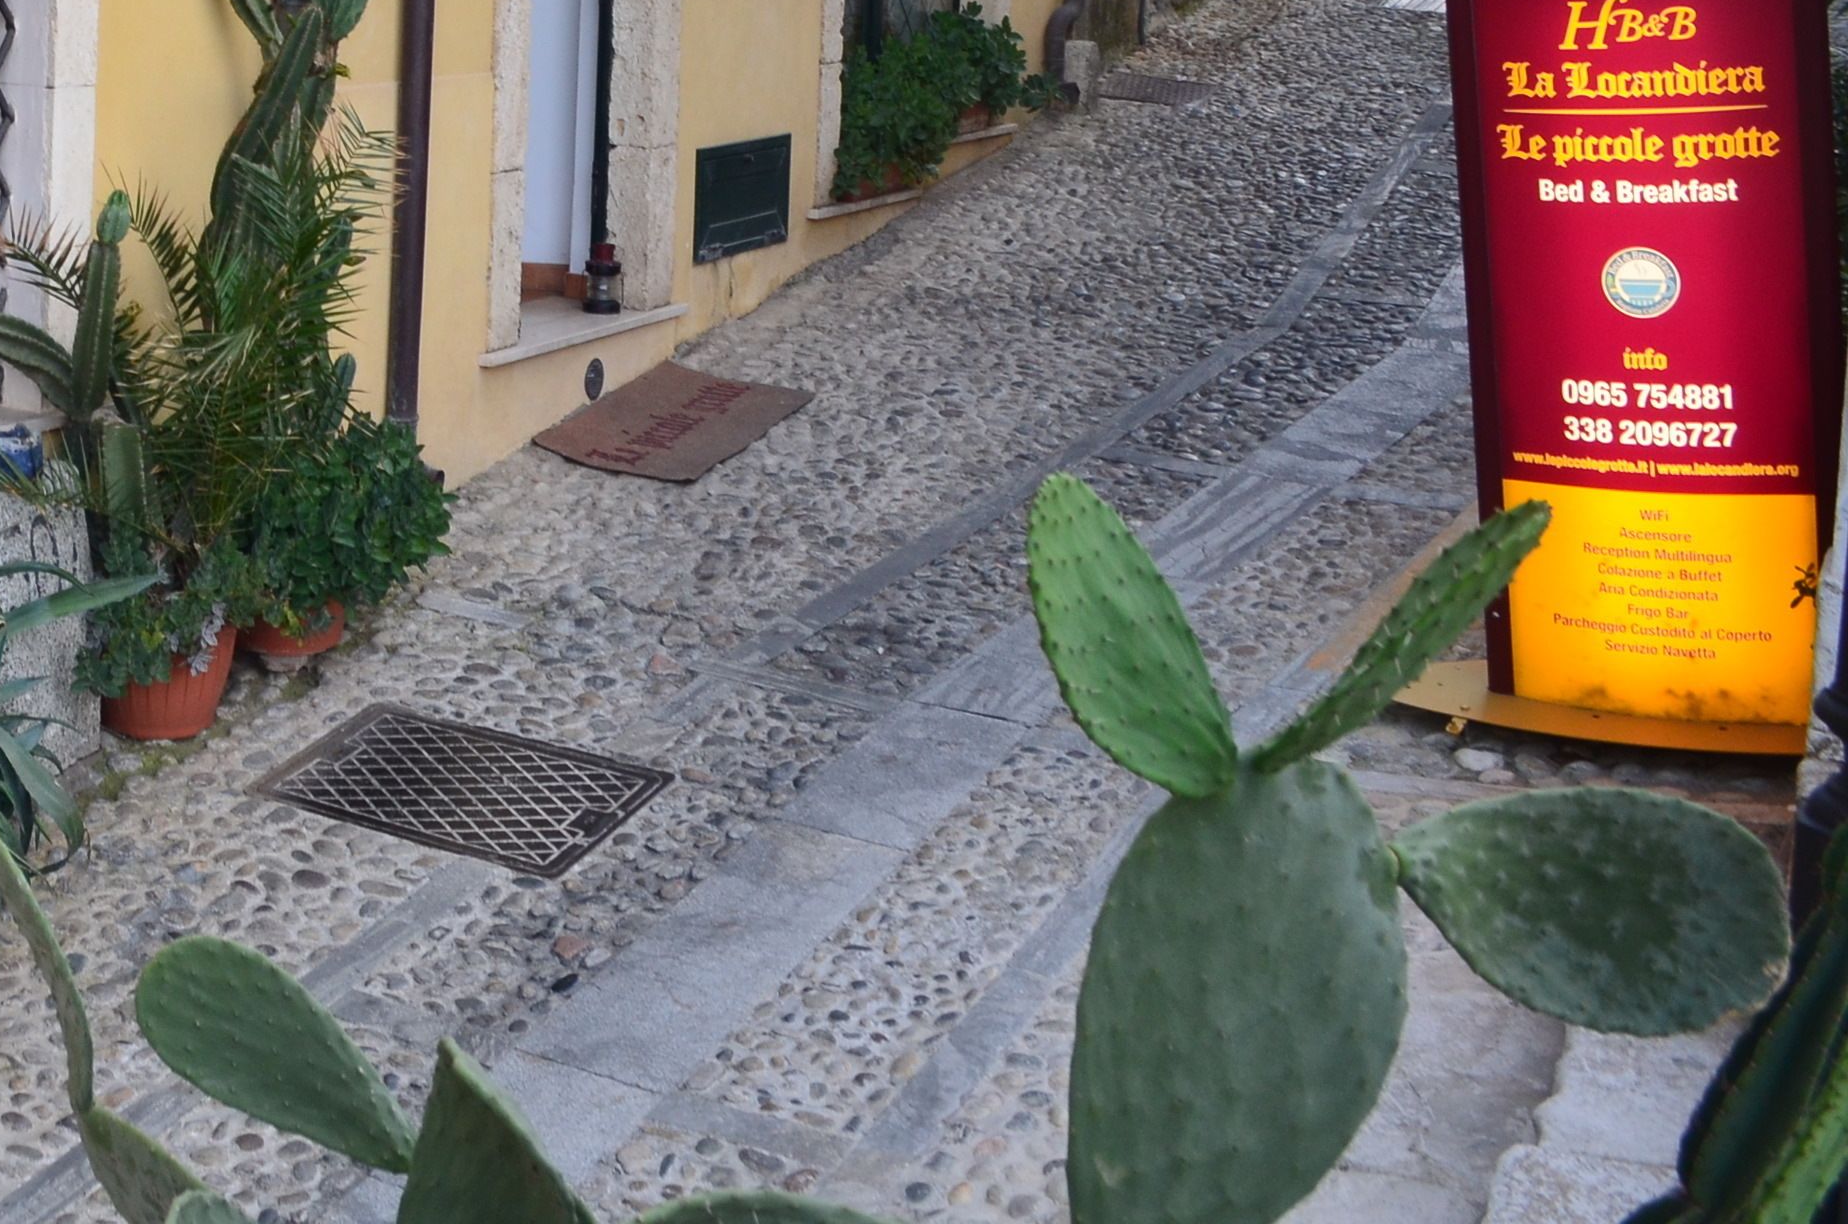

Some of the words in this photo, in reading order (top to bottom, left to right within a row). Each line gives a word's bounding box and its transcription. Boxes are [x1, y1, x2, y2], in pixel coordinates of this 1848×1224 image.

[1502, 62, 1557, 98] La
[1561, 60, 1766, 99] Locandiera
[1496, 124, 1547, 160] Le
[1552, 128, 1664, 167] piccole
[1672, 126, 1780, 167] grotte
[1538, 178, 1584, 203] Bed
[1590, 180, 1611, 203] &
[1616, 178, 1739, 204] Breakfast
[1623, 347, 1668, 371] info
[1561, 379, 1628, 407] 0965
[1633, 383, 1733, 409] 754881
[1563, 416, 1613, 444] 338
[1619, 420, 1738, 448] 2096727
[1639, 509, 1670, 521] WiFi
[1619, 527, 1693, 543] Ascensore
[1583, 542, 1650, 562] Reception
[1655, 548, 1733, 565] Multilingua
[1598, 562, 1663, 579] Colazione
[1667, 571, 1675, 580] a
[1679, 569, 1723, 582] Buffet
[1598, 582, 1625, 595] Aria
[1629, 584, 1720, 602] Condizionata
[1627, 603, 1662, 619] Frigo
[1666, 607, 1689, 619] Bar
[1553, 612, 1627, 634] Parcheggio
[1630, 623, 1696, 639] Custodito
[1700, 628, 1712, 640] al
[1716, 629, 1773, 643] Coperto
[1604, 639, 1659, 655] Servizio
[1662, 644, 1716, 659] Navetta
